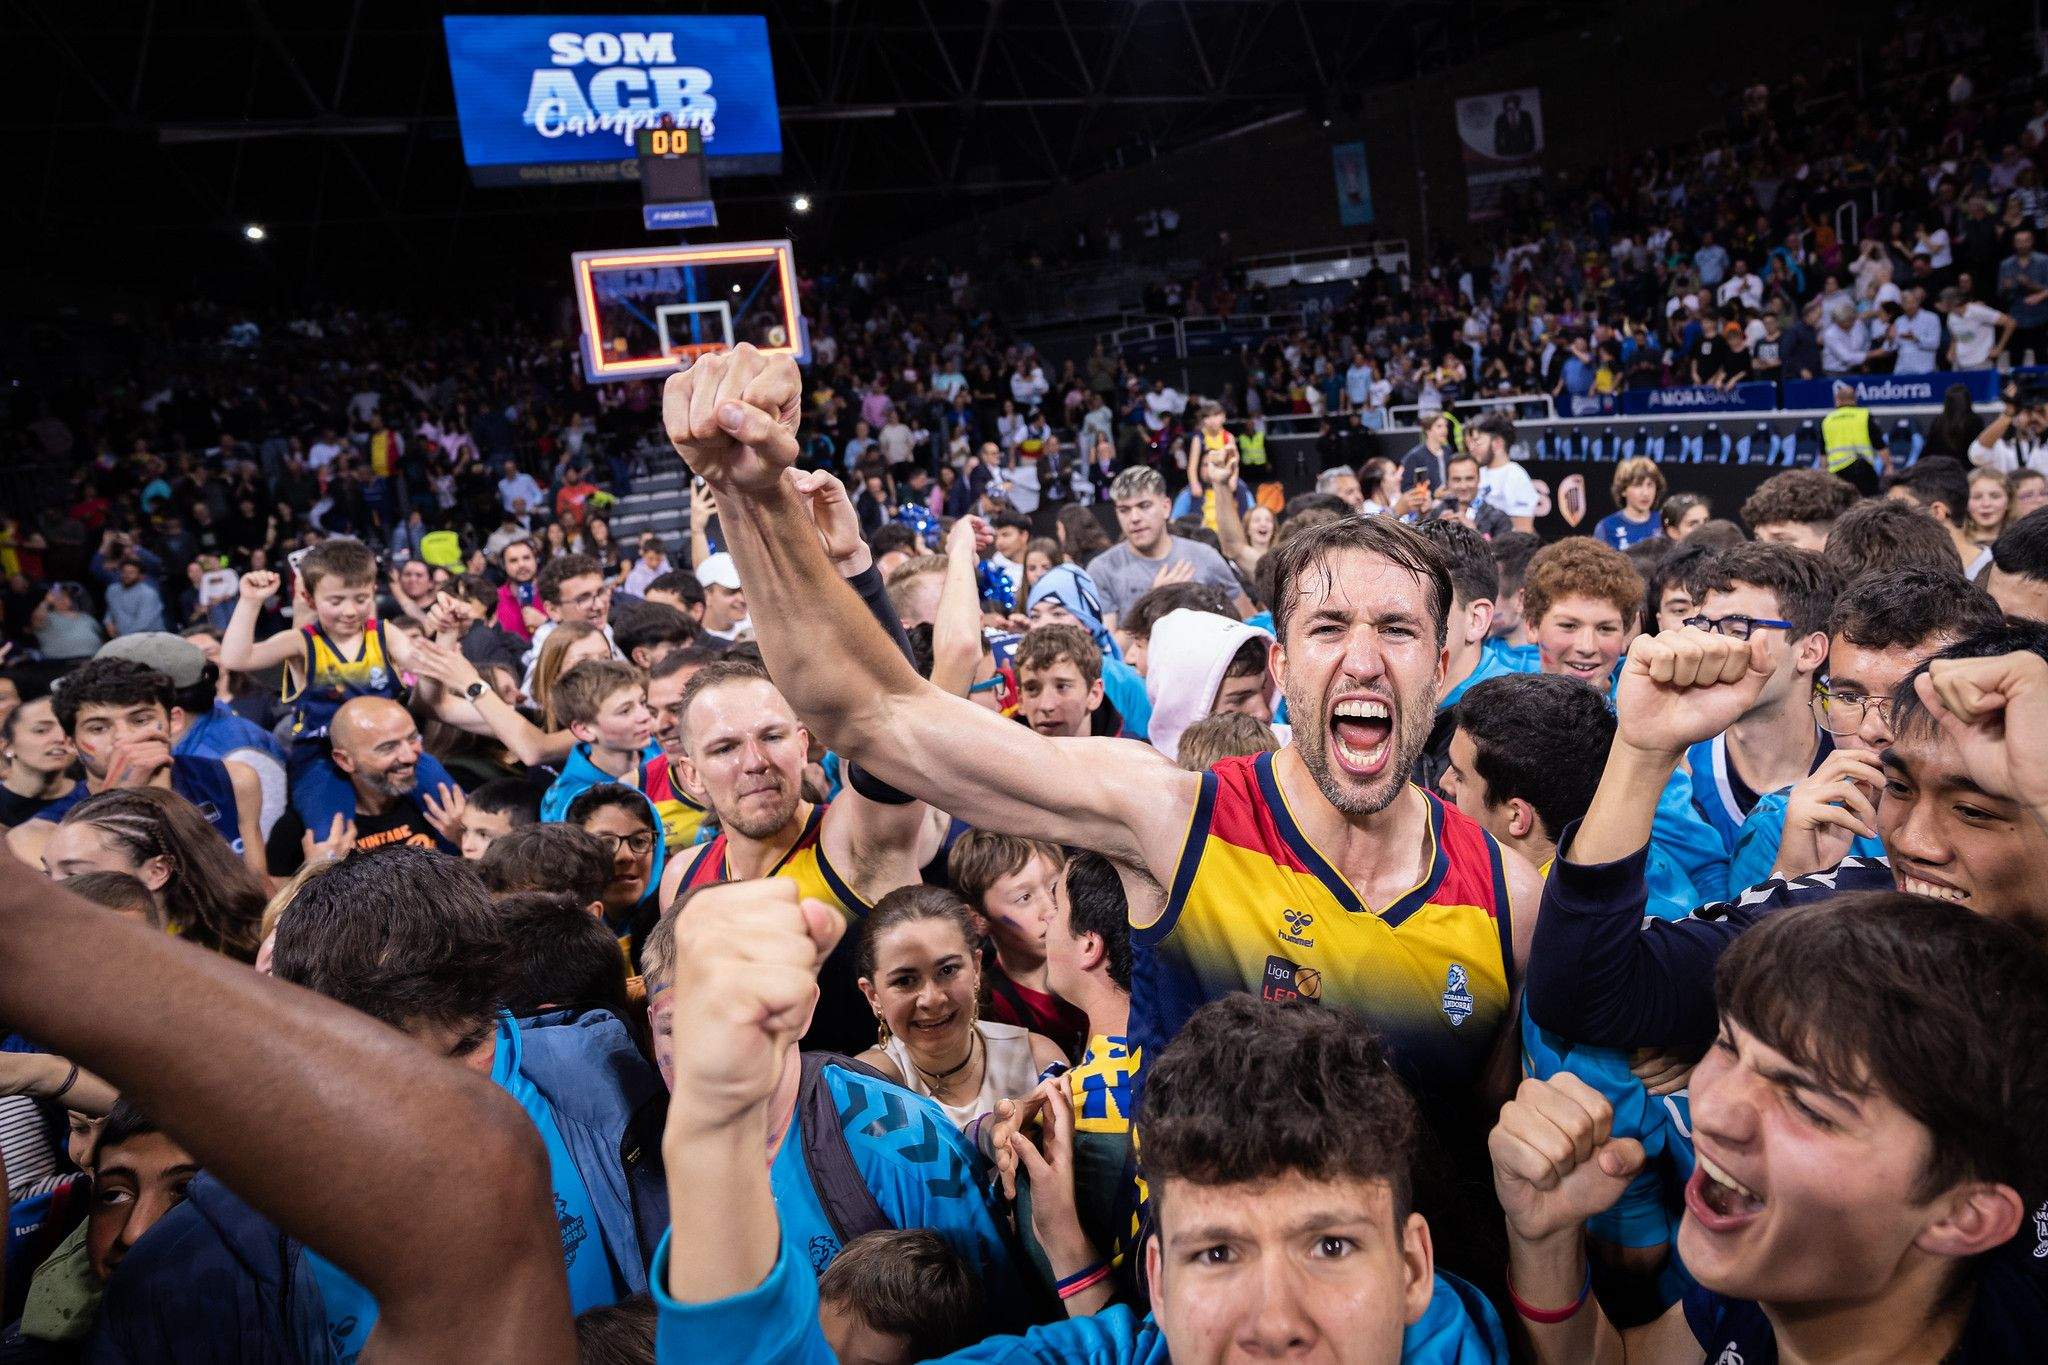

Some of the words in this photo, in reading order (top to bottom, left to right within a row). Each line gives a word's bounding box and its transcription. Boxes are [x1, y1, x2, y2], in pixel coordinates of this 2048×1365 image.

[548, 32, 677, 65] SOM
[523, 66, 718, 126] ACB
[652, 130, 688, 154] 00
[1856, 380, 1933, 401] Andorra
[1278, 929, 1314, 948] hummel
[1267, 963, 1291, 980] Liga
[562, 1227, 586, 1247] ORRA
